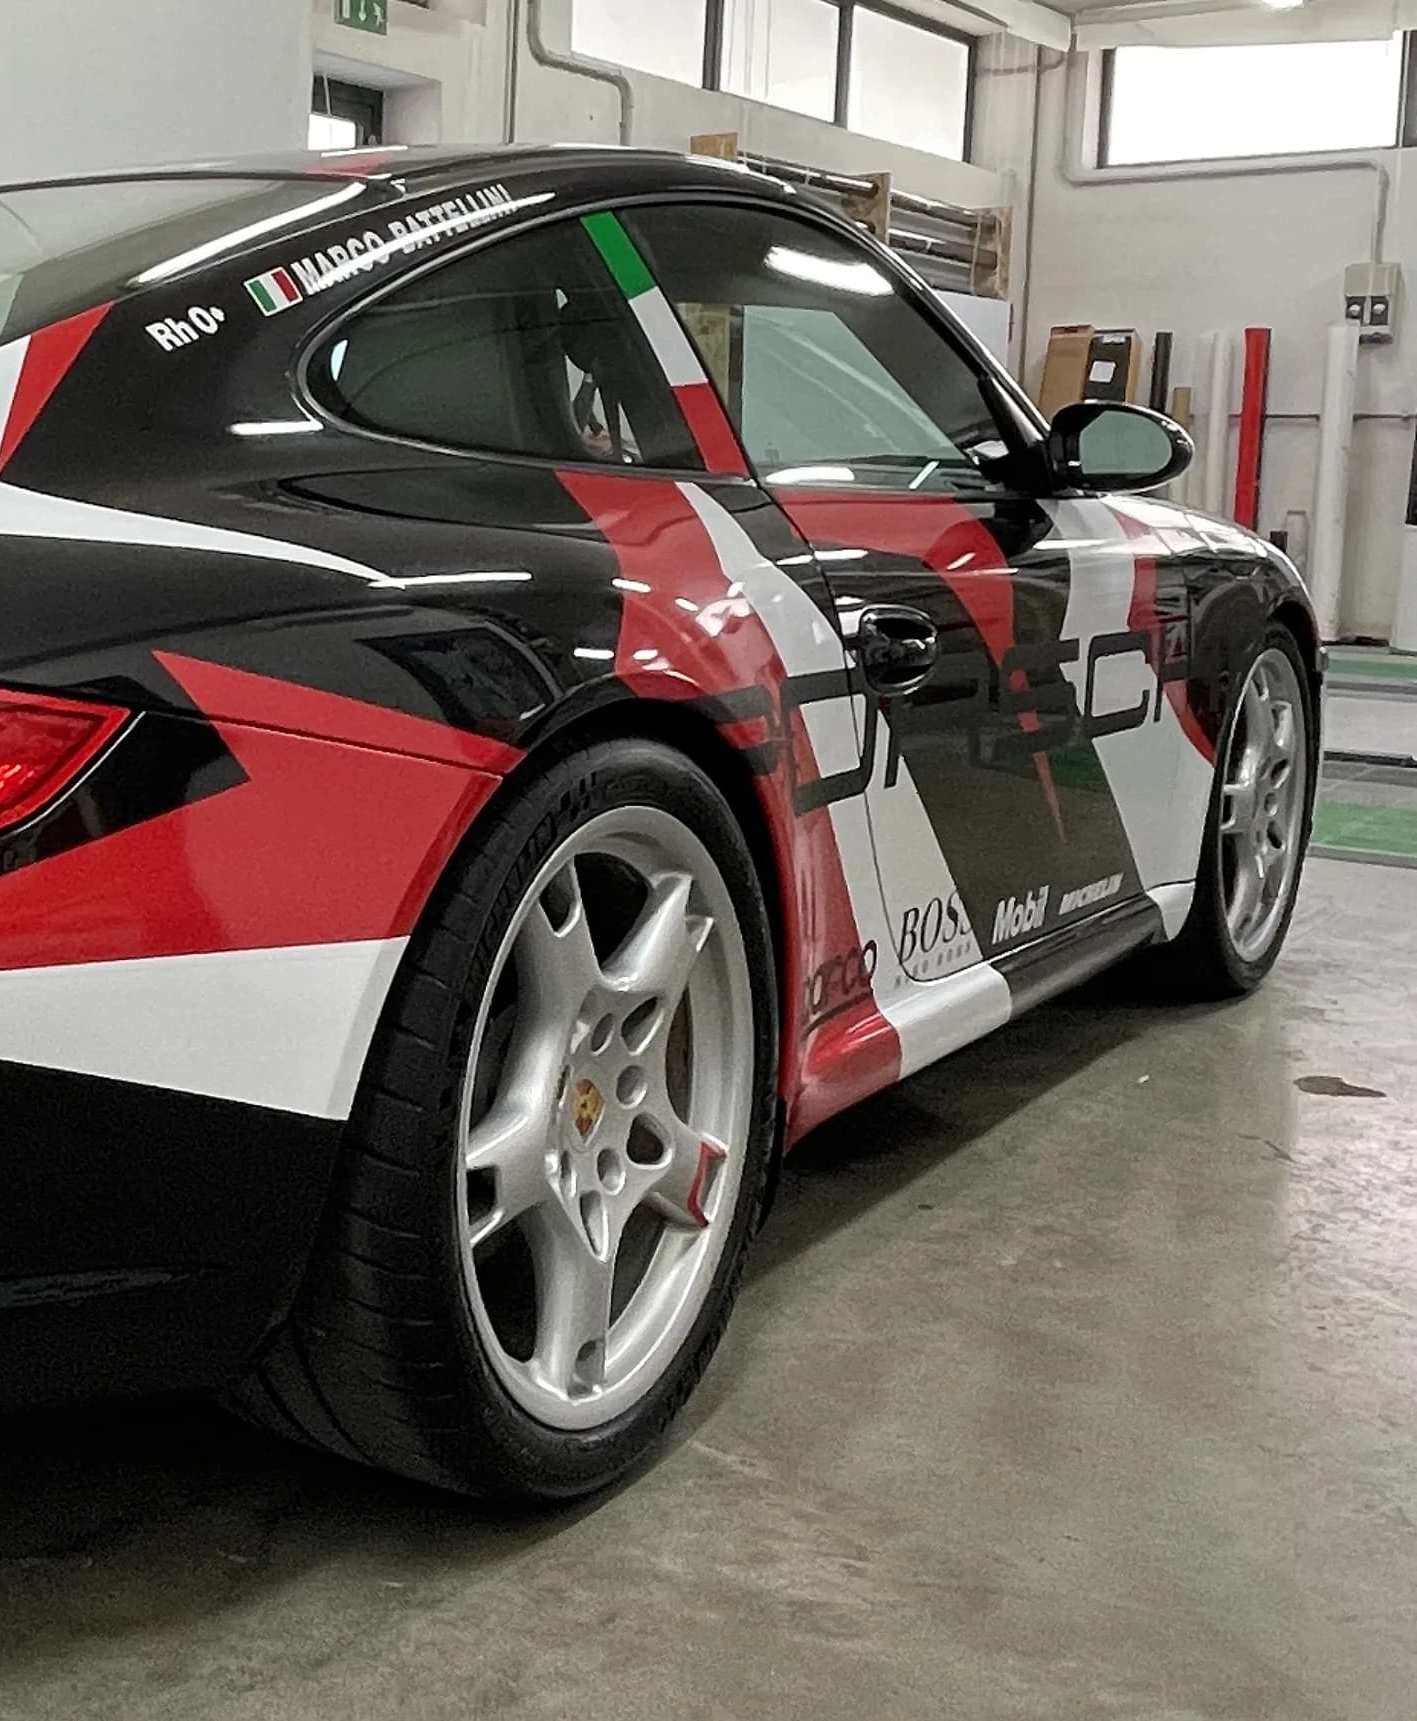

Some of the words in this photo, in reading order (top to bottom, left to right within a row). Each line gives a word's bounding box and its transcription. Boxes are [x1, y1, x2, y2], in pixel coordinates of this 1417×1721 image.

[290, 230, 391, 295] MARCO
[388, 183, 519, 254] BATTELLINI
[899, 890, 973, 964] BOS
[992, 885, 1049, 945] Mobil
